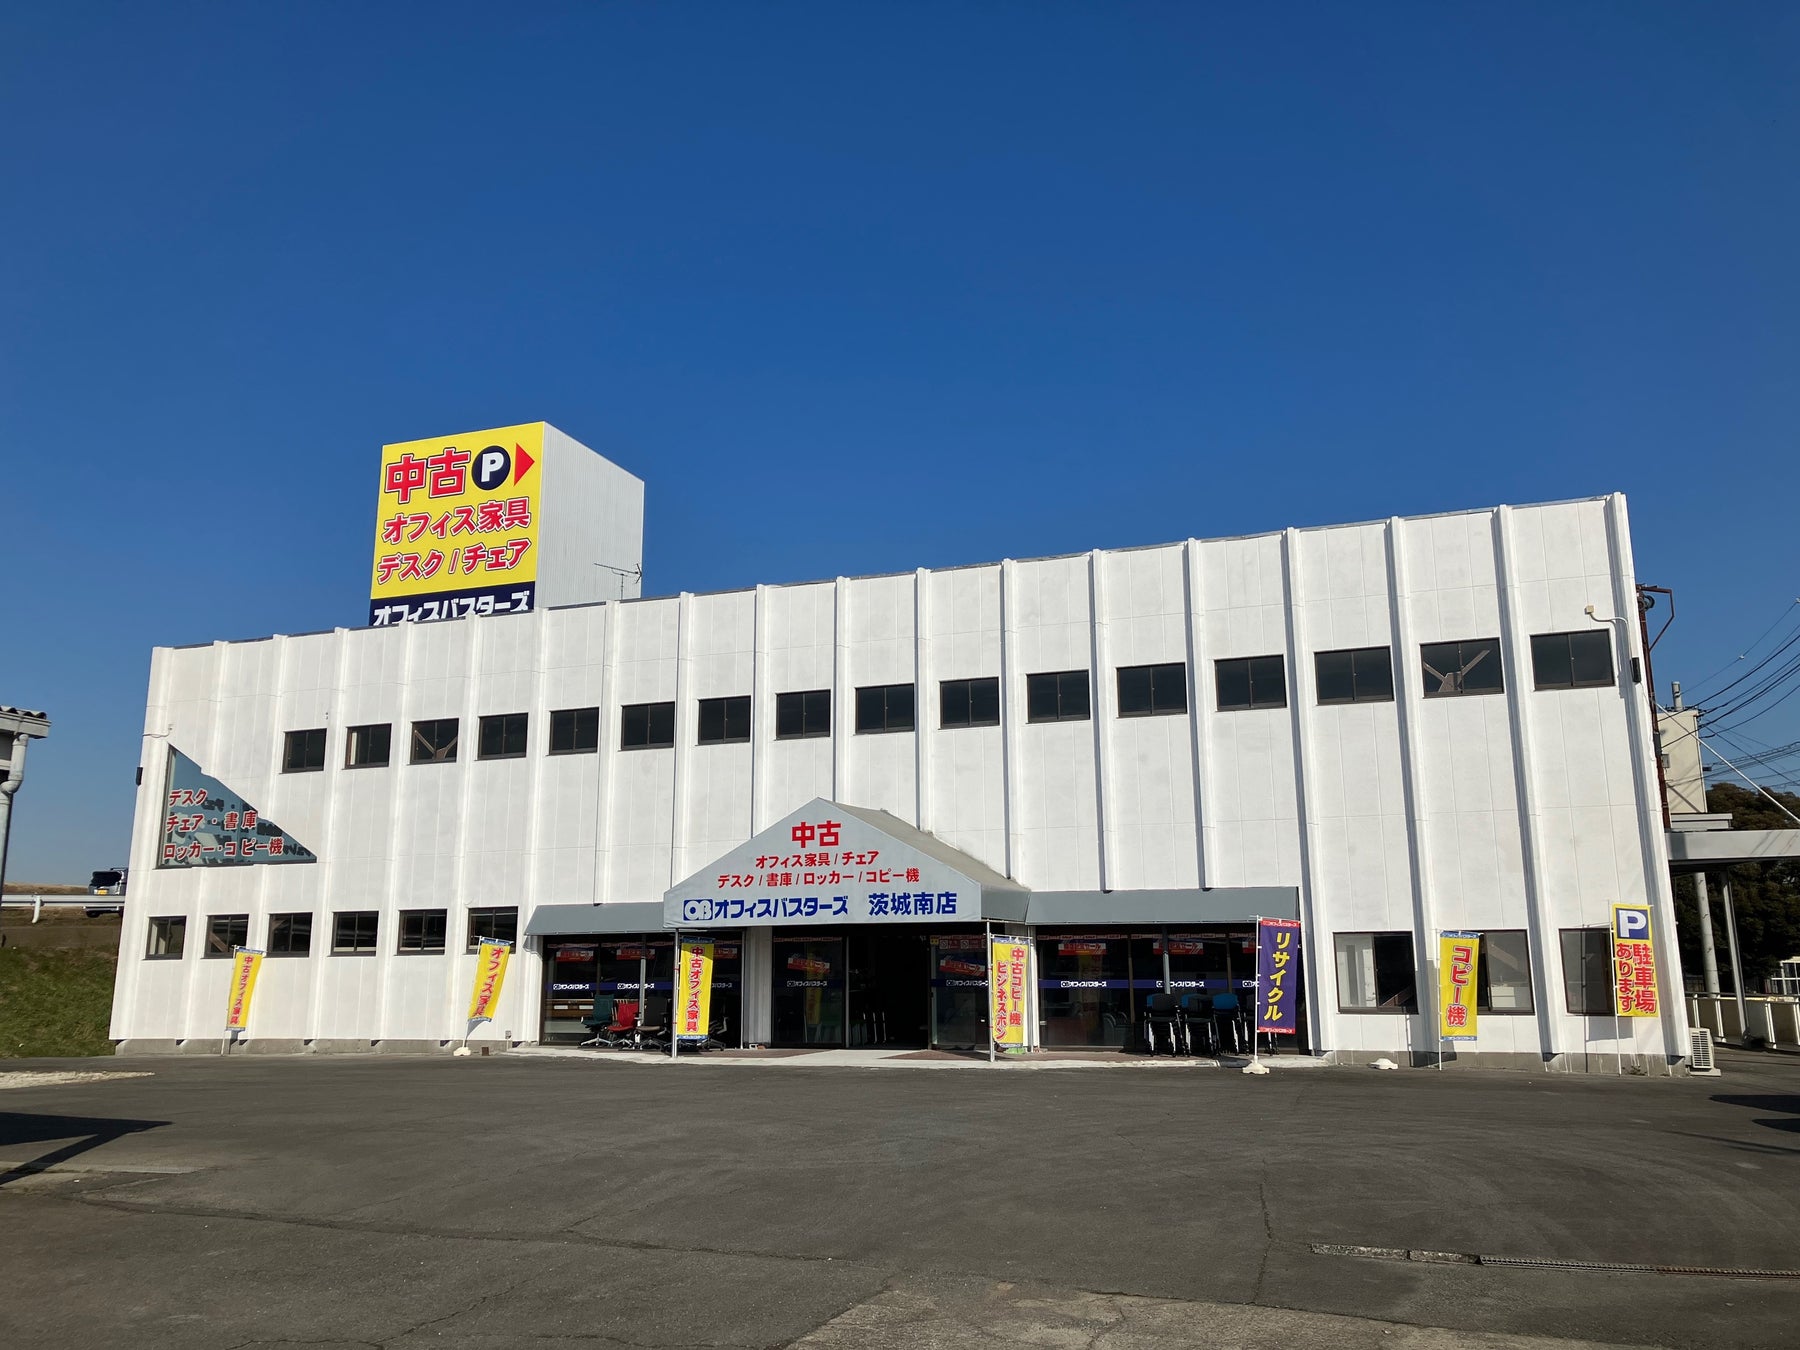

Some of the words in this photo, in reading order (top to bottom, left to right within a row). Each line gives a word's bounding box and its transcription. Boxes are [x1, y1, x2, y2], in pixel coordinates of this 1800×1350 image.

[384, 447, 472, 504] 中古
[480, 451, 504, 482] P
[382, 497, 532, 545] オフィス家具
[168, 789, 208, 806] デスク
[791, 820, 841, 848] 中古
[714, 895, 848, 918] オフィスバスターズ
[868, 891, 957, 916] 茨城南店
[1618, 909, 1647, 938] P
[685, 945, 705, 1032] 中古オフィス家具
[1263, 932, 1291, 1021] リサイクル
[1446, 946, 1473, 1027] コピー機
[1616, 942, 1634, 1013] あります
[1633, 943, 1657, 1014] 駐車場
